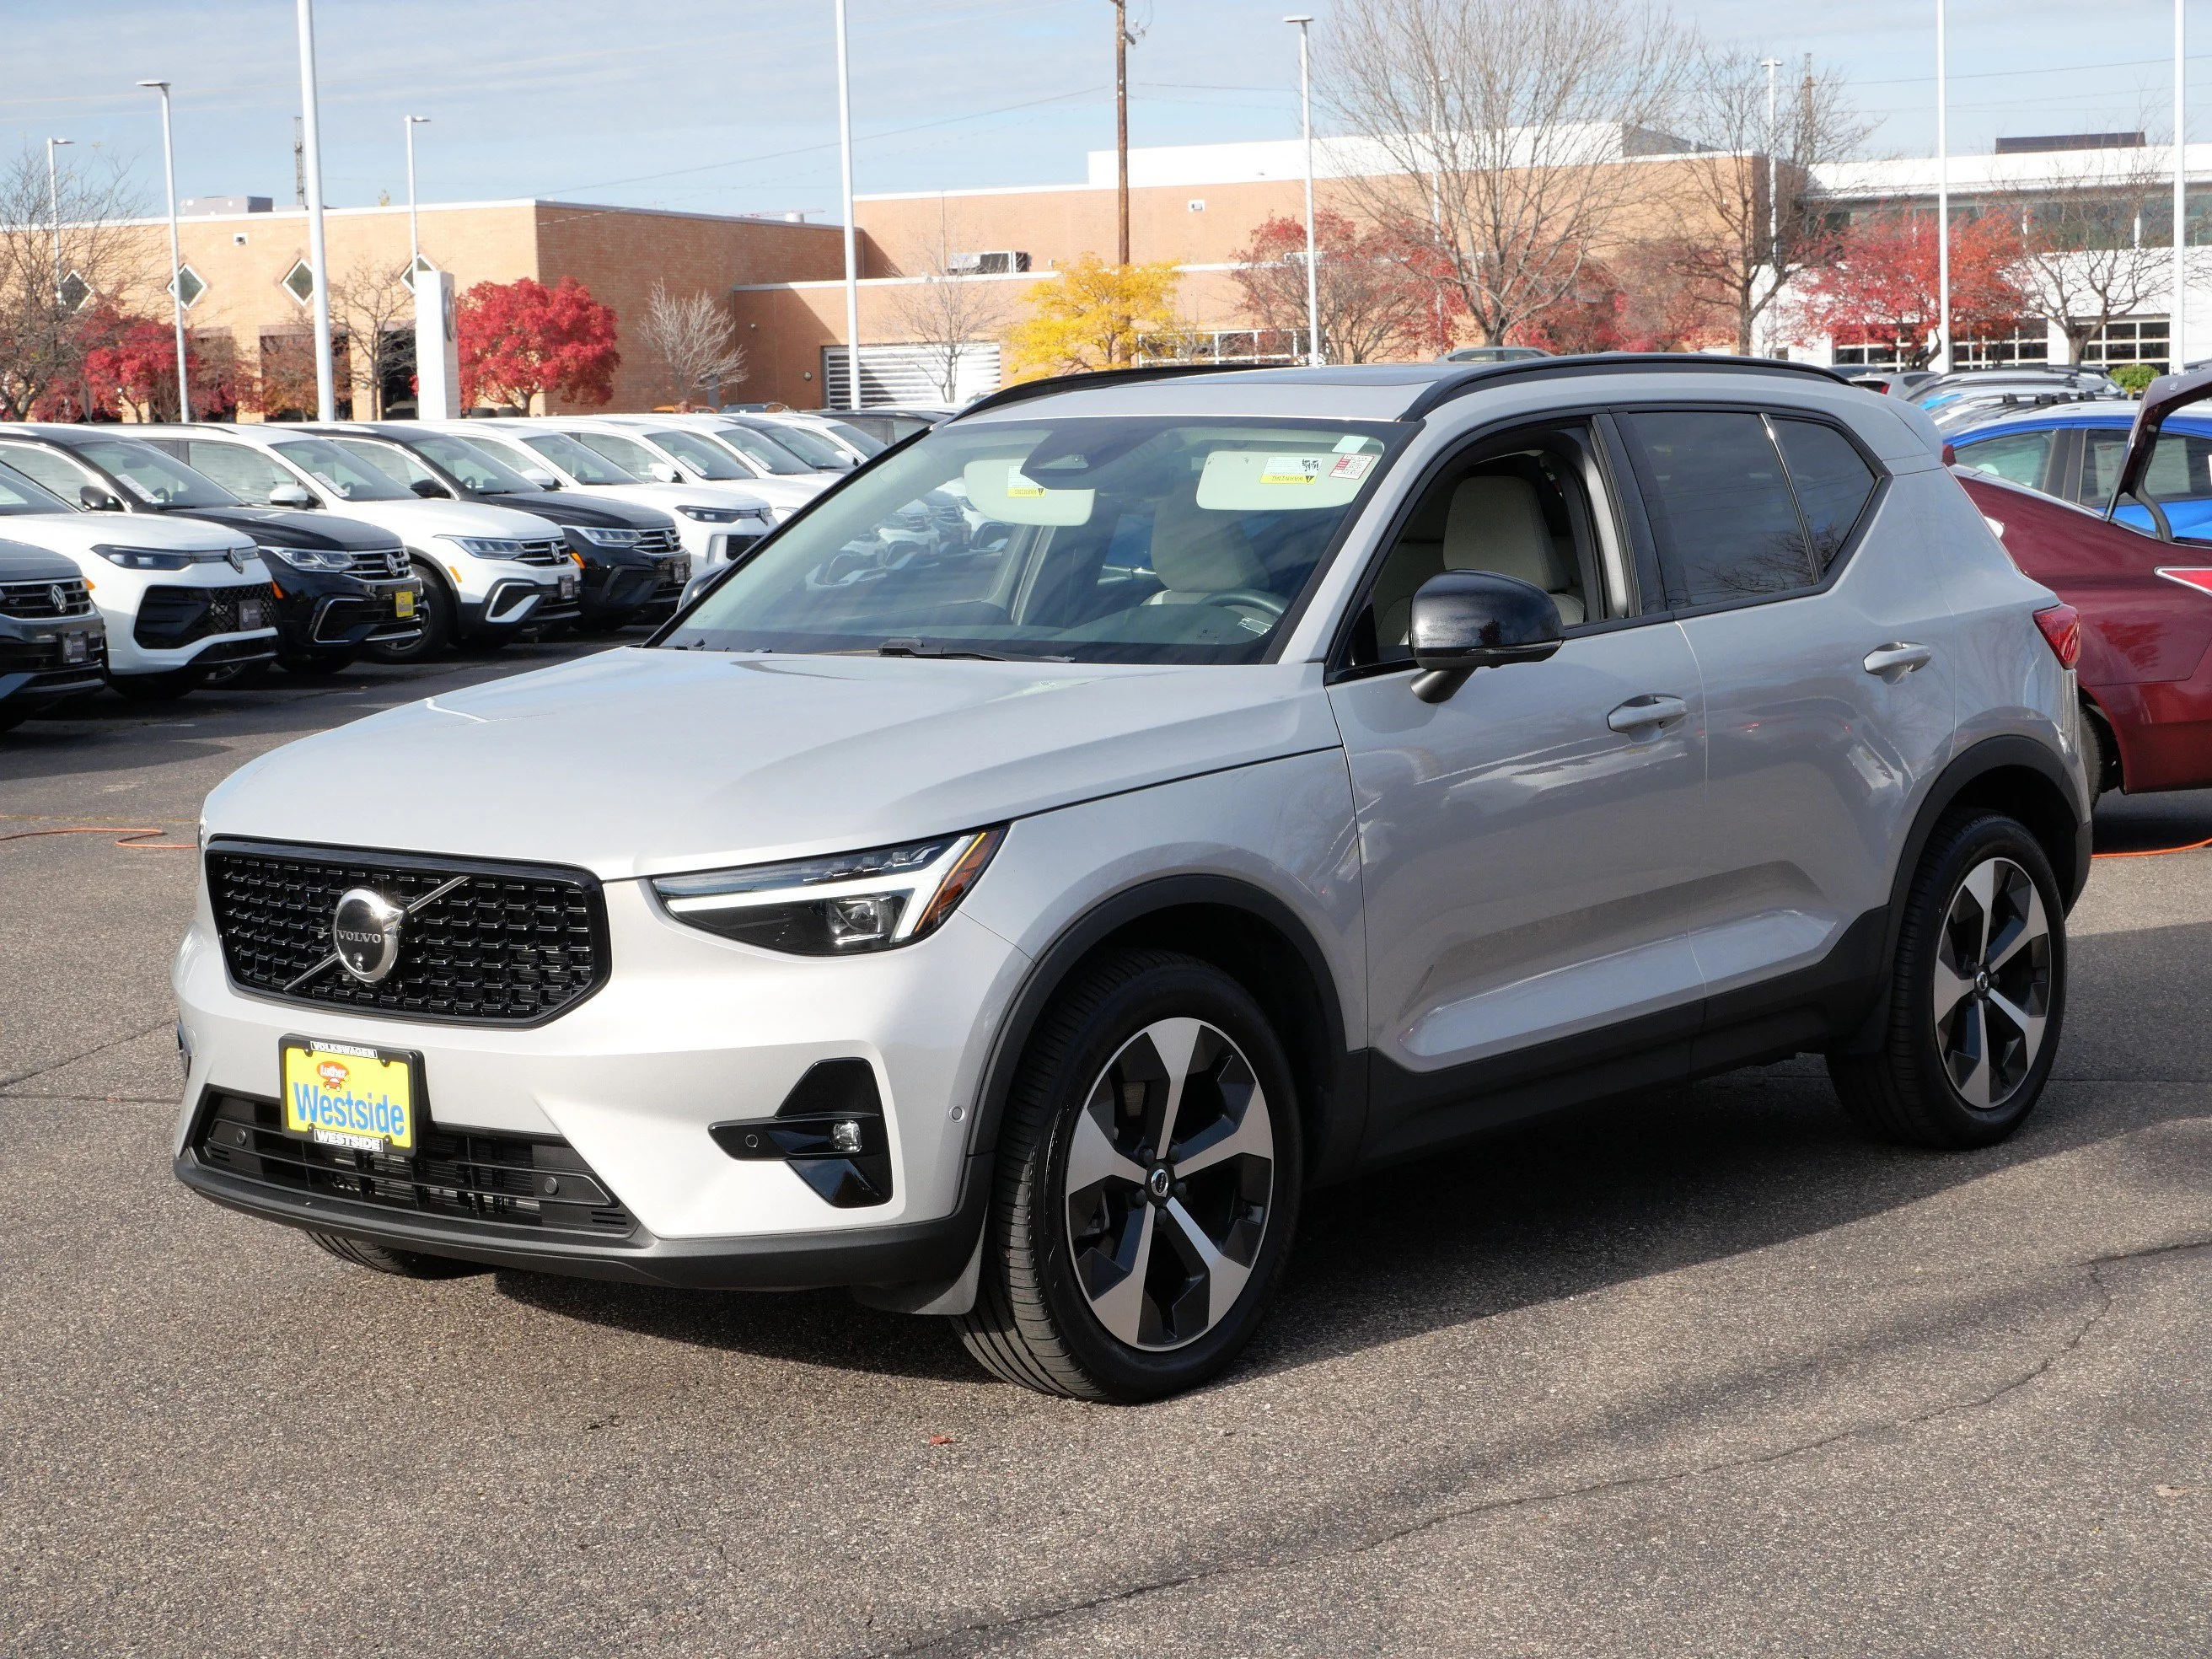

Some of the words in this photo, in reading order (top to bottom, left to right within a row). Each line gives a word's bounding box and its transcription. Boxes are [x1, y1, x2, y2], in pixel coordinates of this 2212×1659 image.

[337, 929, 382, 943] VOLVO
[313, 1042, 375, 1058] VOLKSWAGEN
[319, 1064, 346, 1078] Luther
[293, 1082, 405, 1136] Westside
[316, 1130, 380, 1150] WESTSIDE
